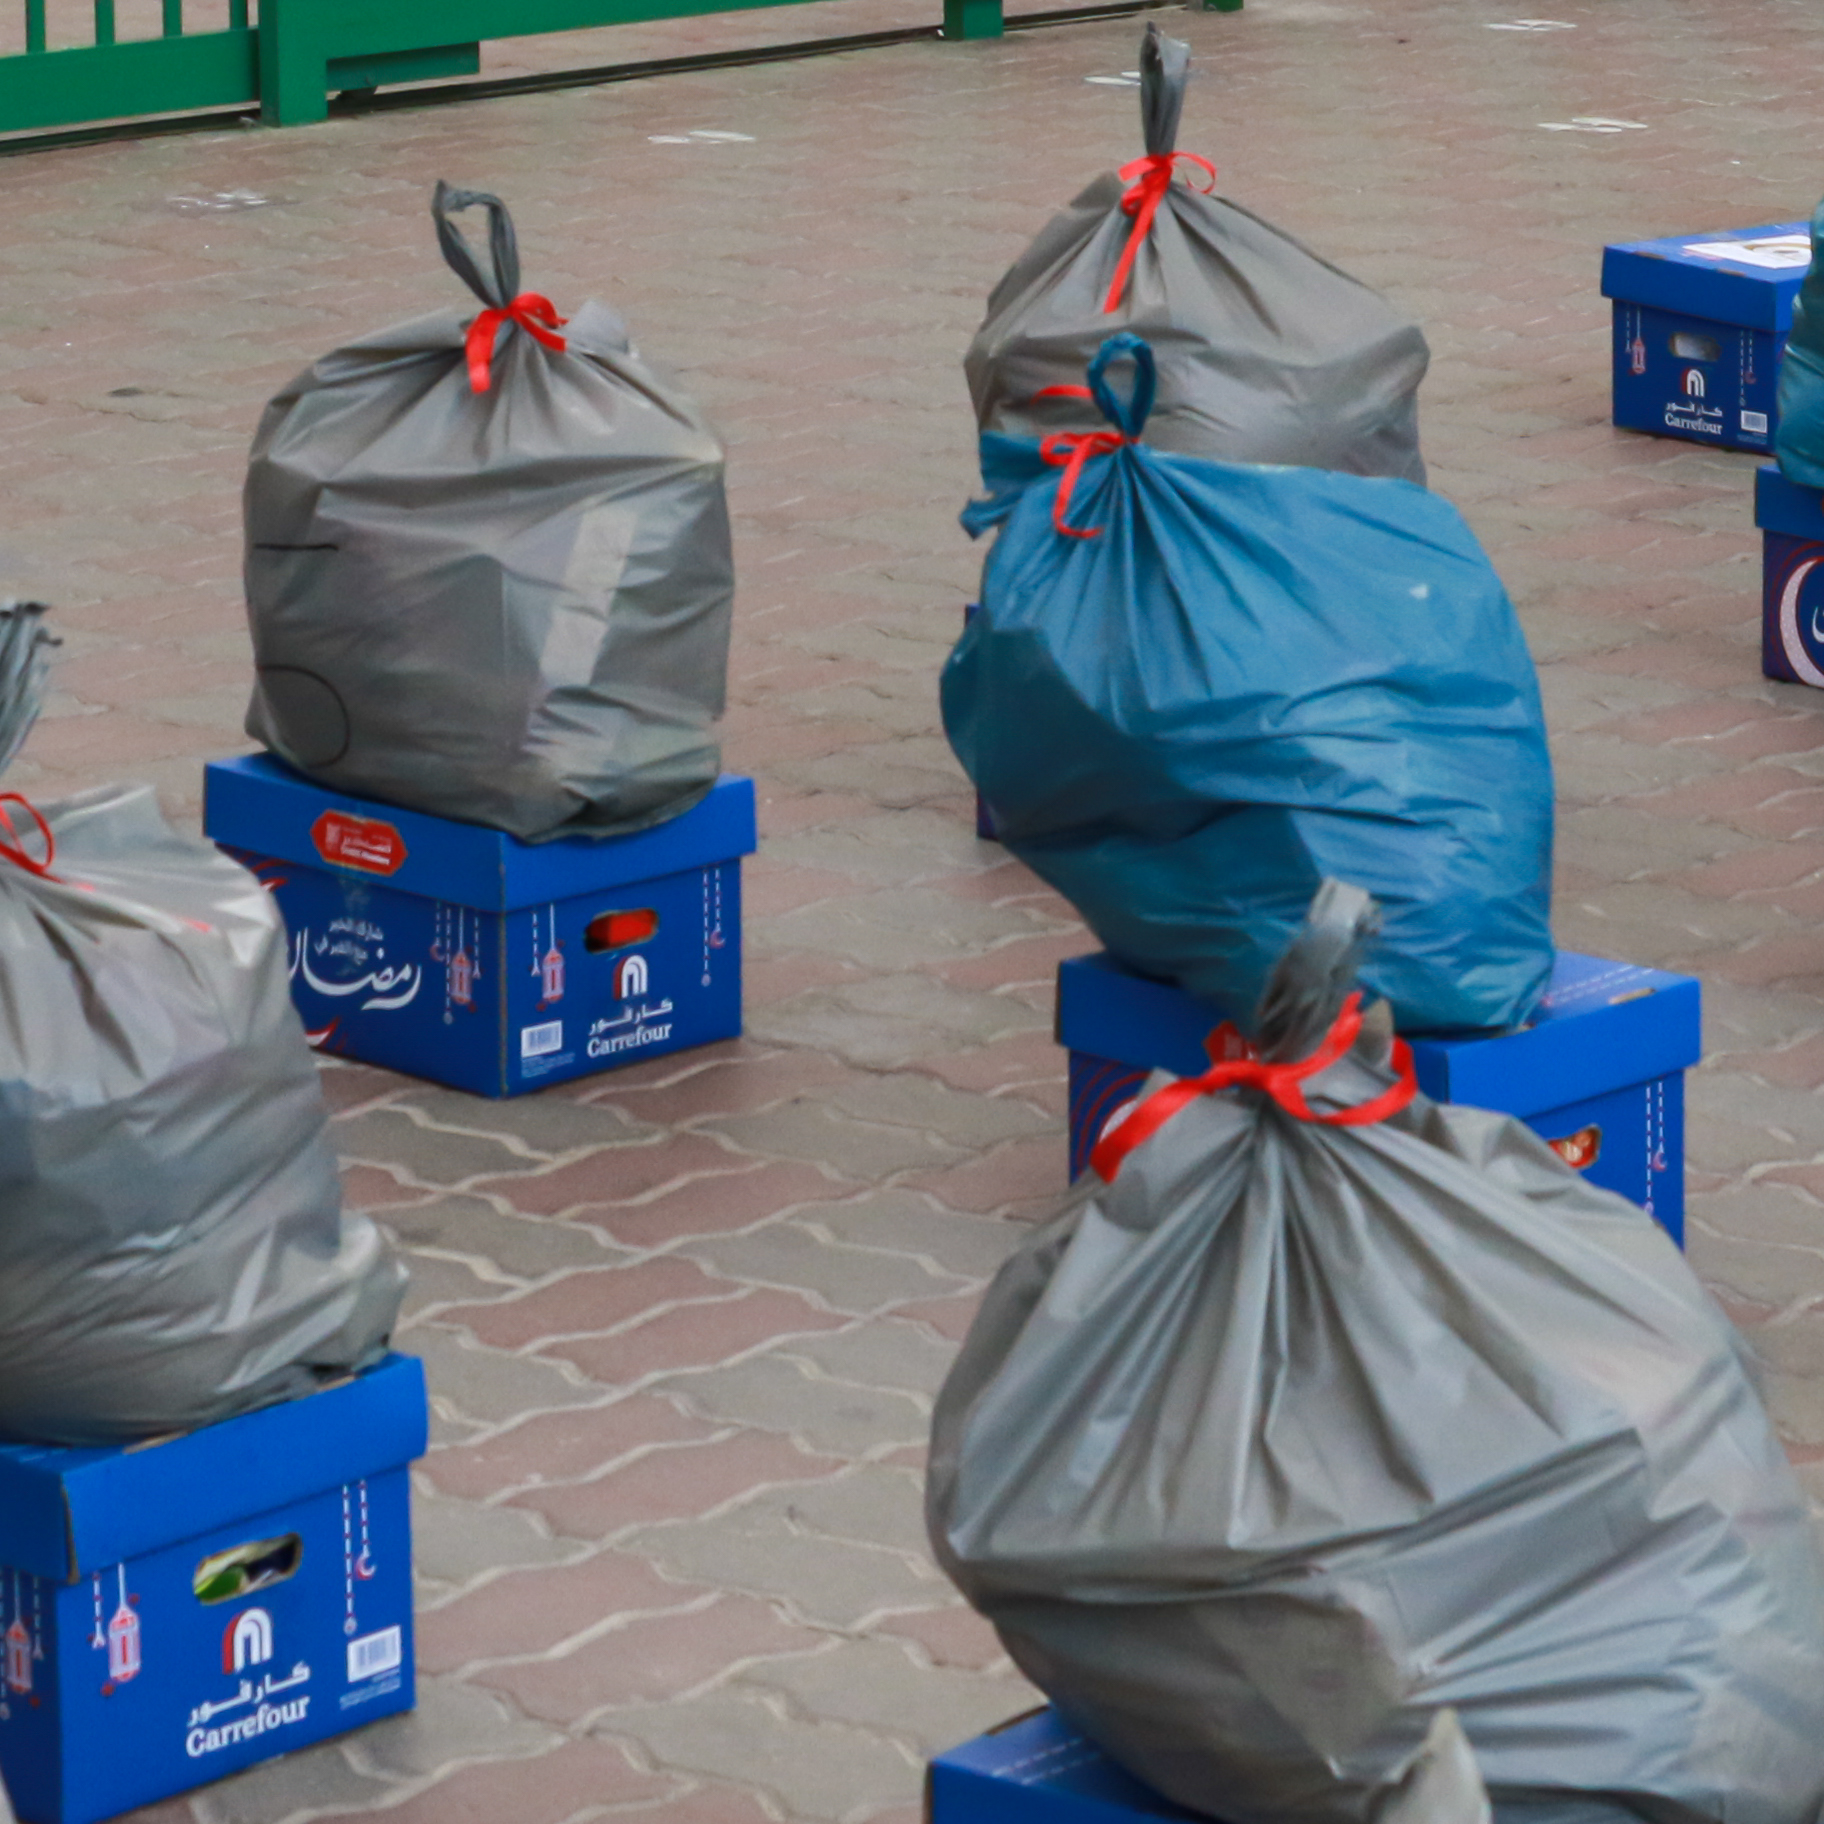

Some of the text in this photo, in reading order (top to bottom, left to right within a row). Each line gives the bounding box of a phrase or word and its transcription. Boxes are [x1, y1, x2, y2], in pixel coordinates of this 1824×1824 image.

[1665, 412, 1723, 435] Carrefour
[587, 1023, 673, 1058] Carrefour
[186, 1696, 311, 1758] Carrefour
